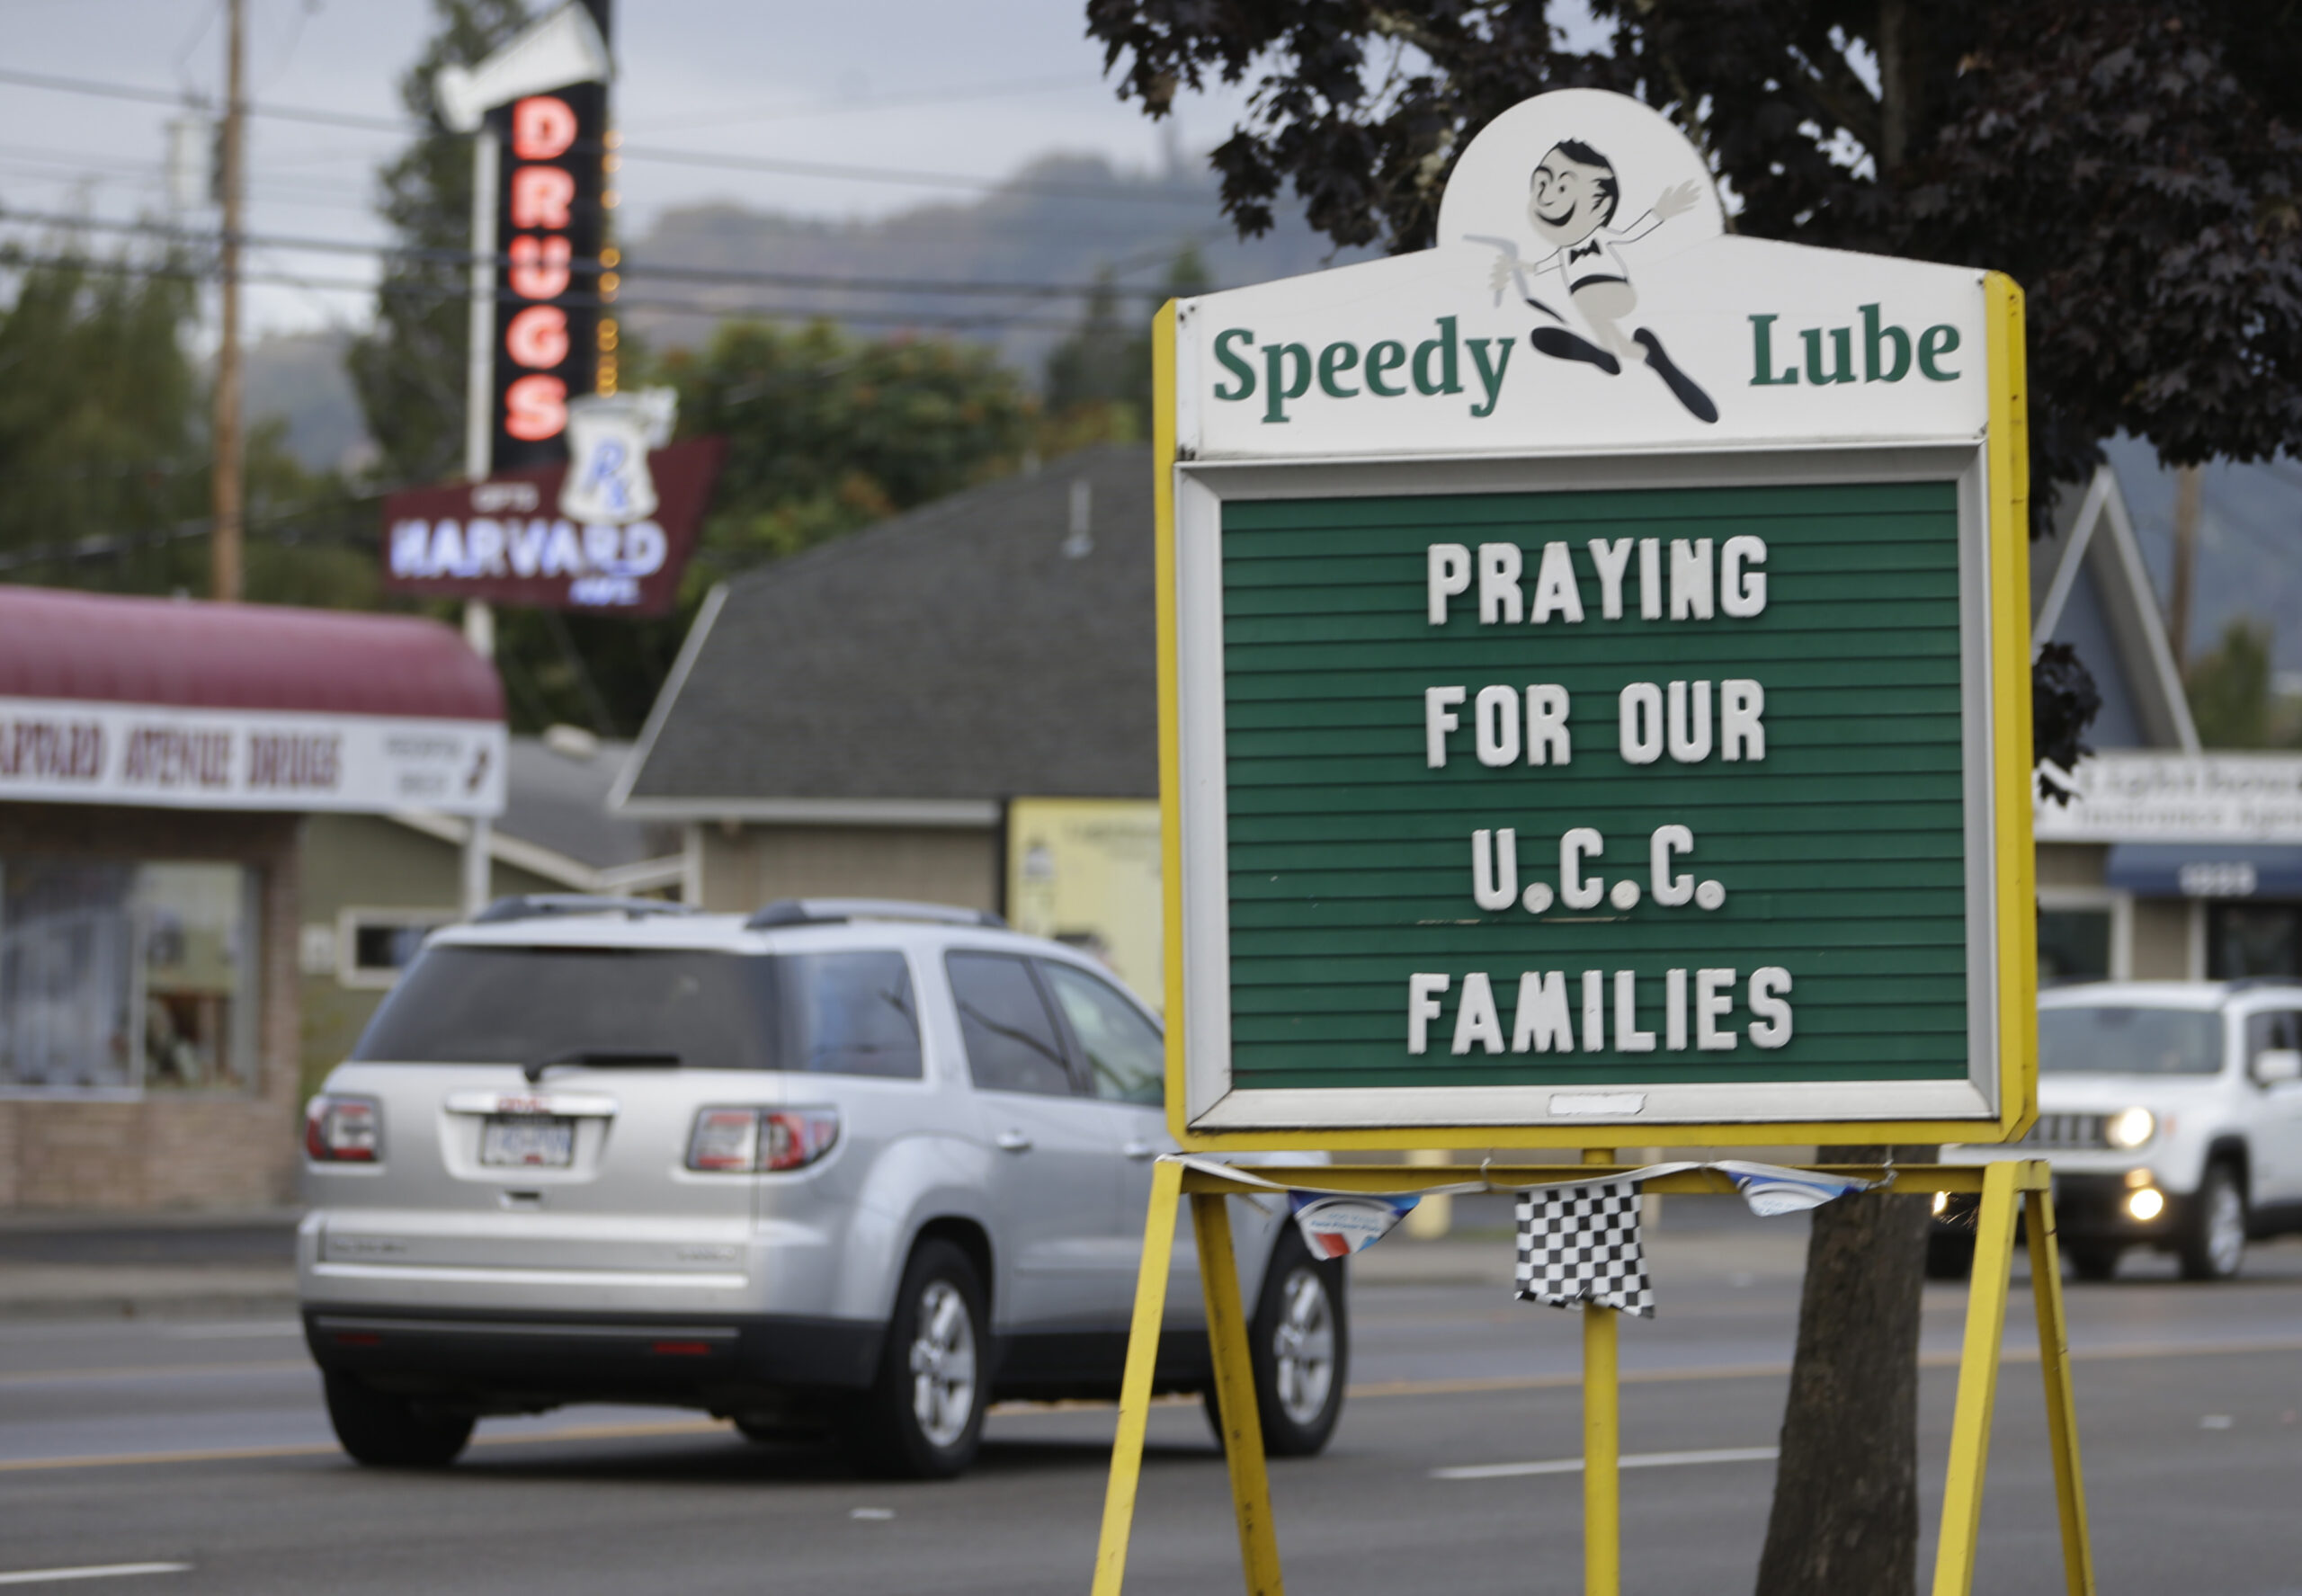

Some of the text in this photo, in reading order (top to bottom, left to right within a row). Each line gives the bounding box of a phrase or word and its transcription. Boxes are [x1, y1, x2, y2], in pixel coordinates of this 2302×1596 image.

[504, 94, 577, 441] DRUGS
[1213, 302, 1962, 424] Speedy Lube
[389, 518, 669, 578] HARVARD
[1427, 535, 1768, 625] PRAYING
[1425, 679, 1766, 768] FOR OUR
[1471, 825, 1726, 914] U.C.C.
[1406, 966, 1794, 1056] FAMILIES
